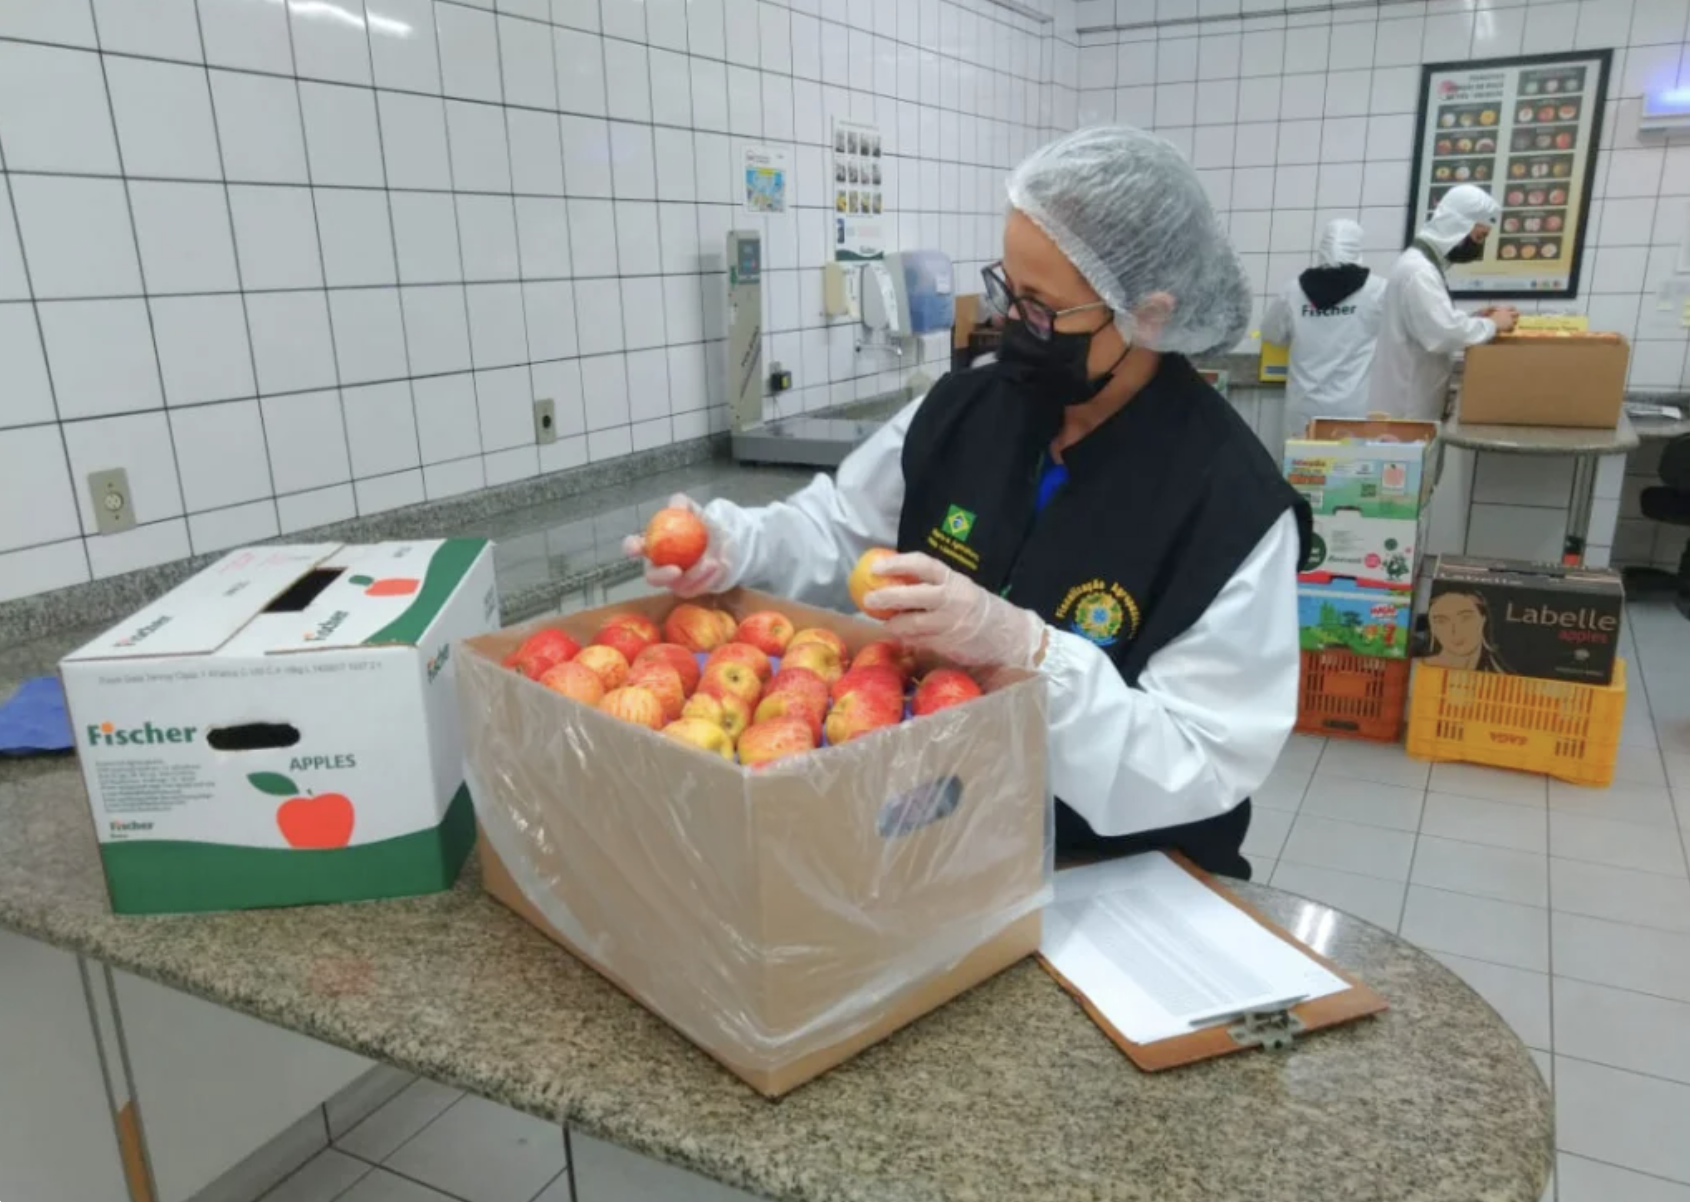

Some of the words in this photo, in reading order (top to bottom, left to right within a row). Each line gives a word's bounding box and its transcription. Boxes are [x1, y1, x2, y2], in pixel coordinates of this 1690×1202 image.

[1302, 304, 1357, 317] Fischer
[1506, 603, 1617, 631] Labelle
[1558, 629, 1608, 644] apples
[88, 720, 198, 747] Fischer
[288, 753, 357, 772] APPLES
